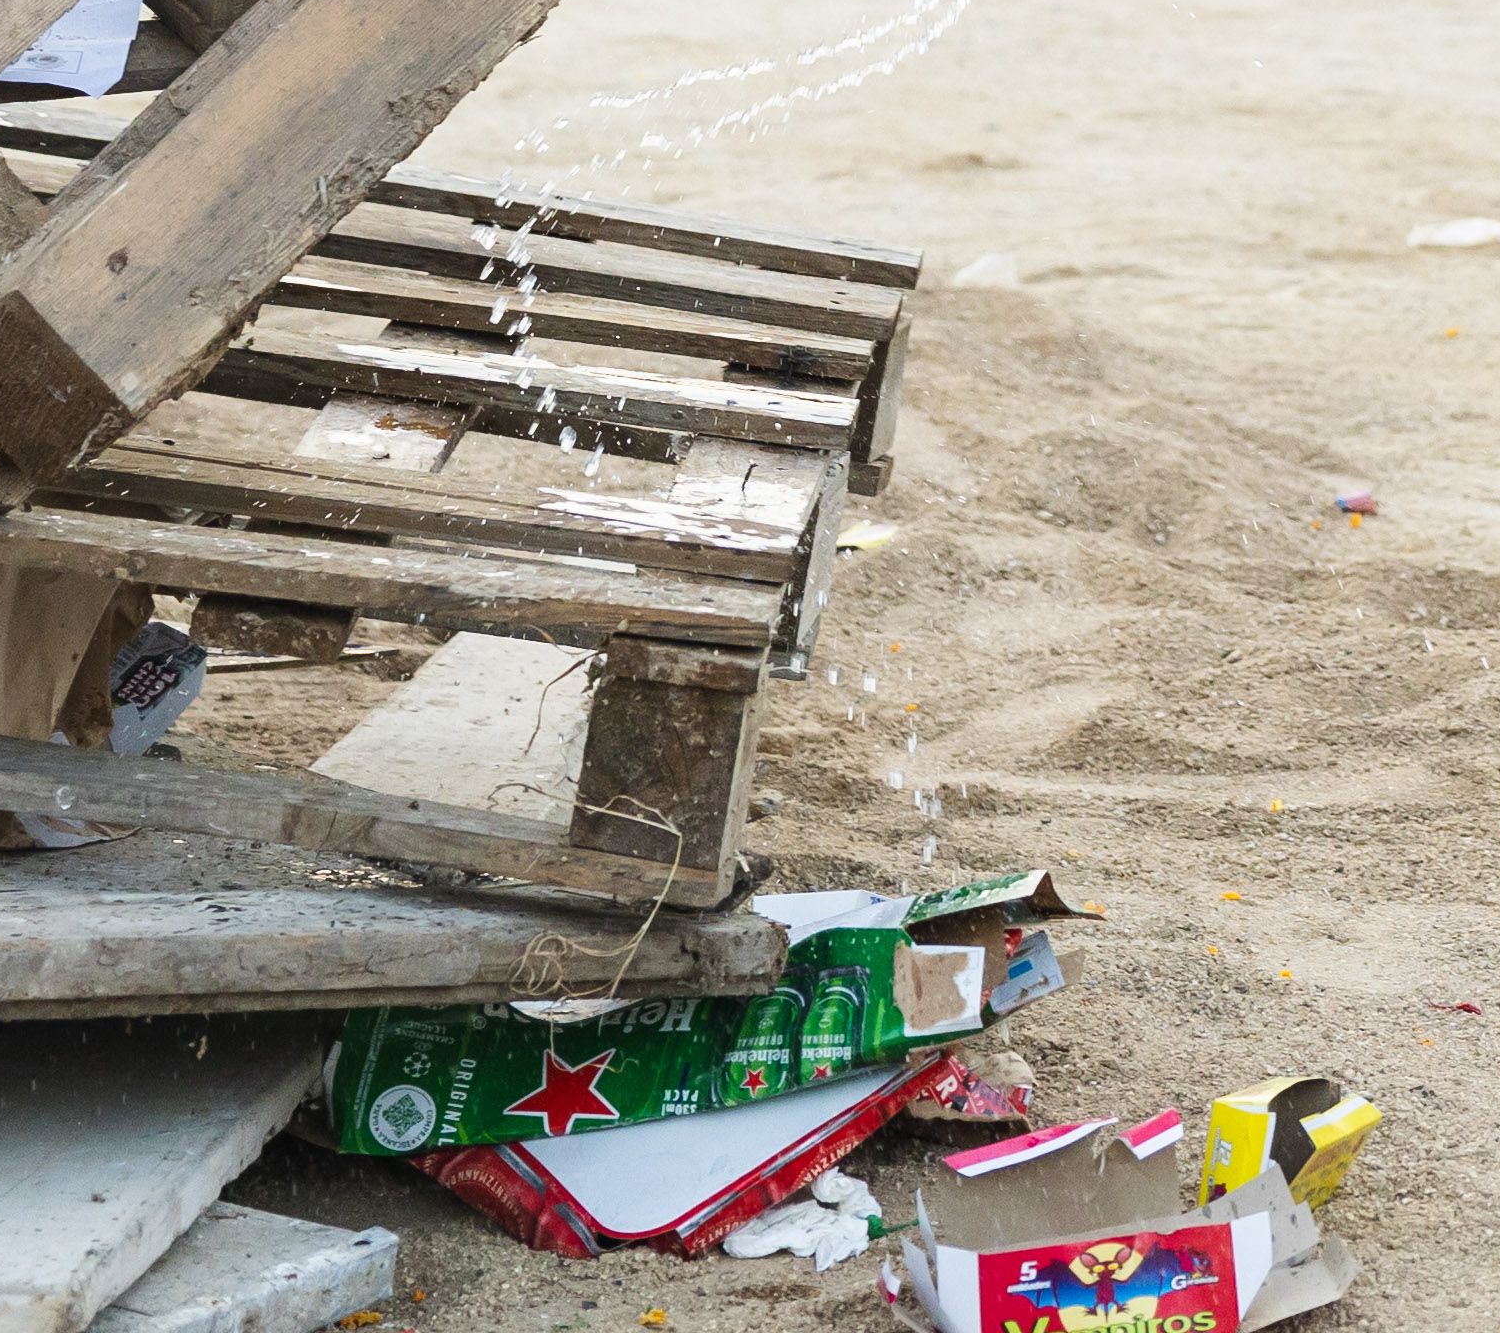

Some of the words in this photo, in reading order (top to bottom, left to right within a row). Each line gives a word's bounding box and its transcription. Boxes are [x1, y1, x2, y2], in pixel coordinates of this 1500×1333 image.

[437, 1058, 477, 1147] ORIGINAL
[662, 1088, 700, 1102] PACK
[1019, 1260, 1038, 1282] 5
